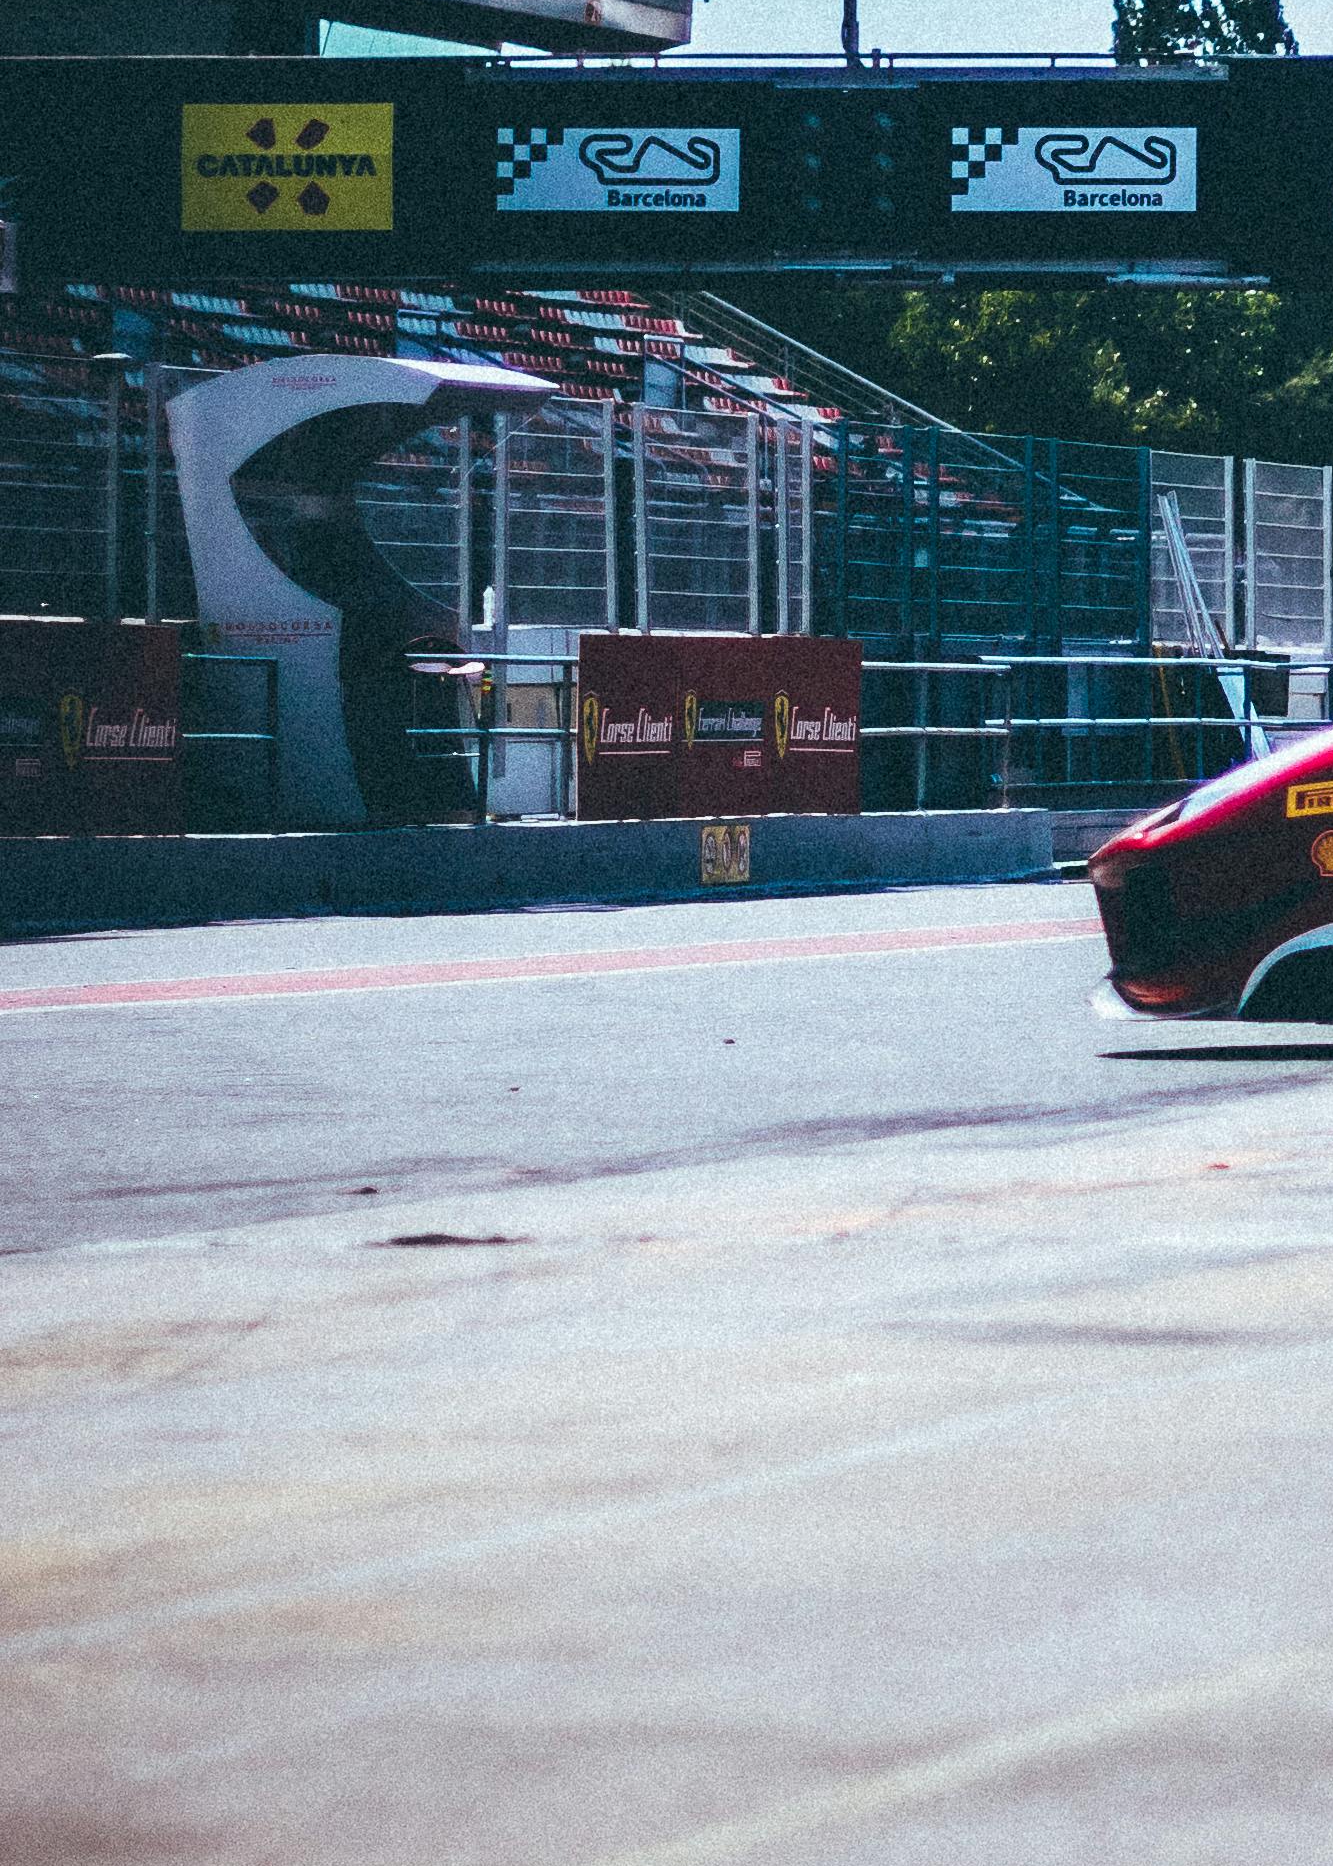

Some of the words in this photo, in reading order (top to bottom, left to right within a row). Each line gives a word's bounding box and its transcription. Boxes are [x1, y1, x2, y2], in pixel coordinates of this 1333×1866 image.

[197, 153, 377, 177] CATALUNYA
[607, 188, 707, 208] Barcelona
[1063, 188, 1163, 207] Barcelona
[86, 706, 128, 747] Corse
[129, 707, 177, 747] Clienti
[599, 707, 634, 744] Corse
[636, 707, 673, 743] Clienti
[790, 706, 820, 741] Corse
[823, 707, 857, 742] Clienti
